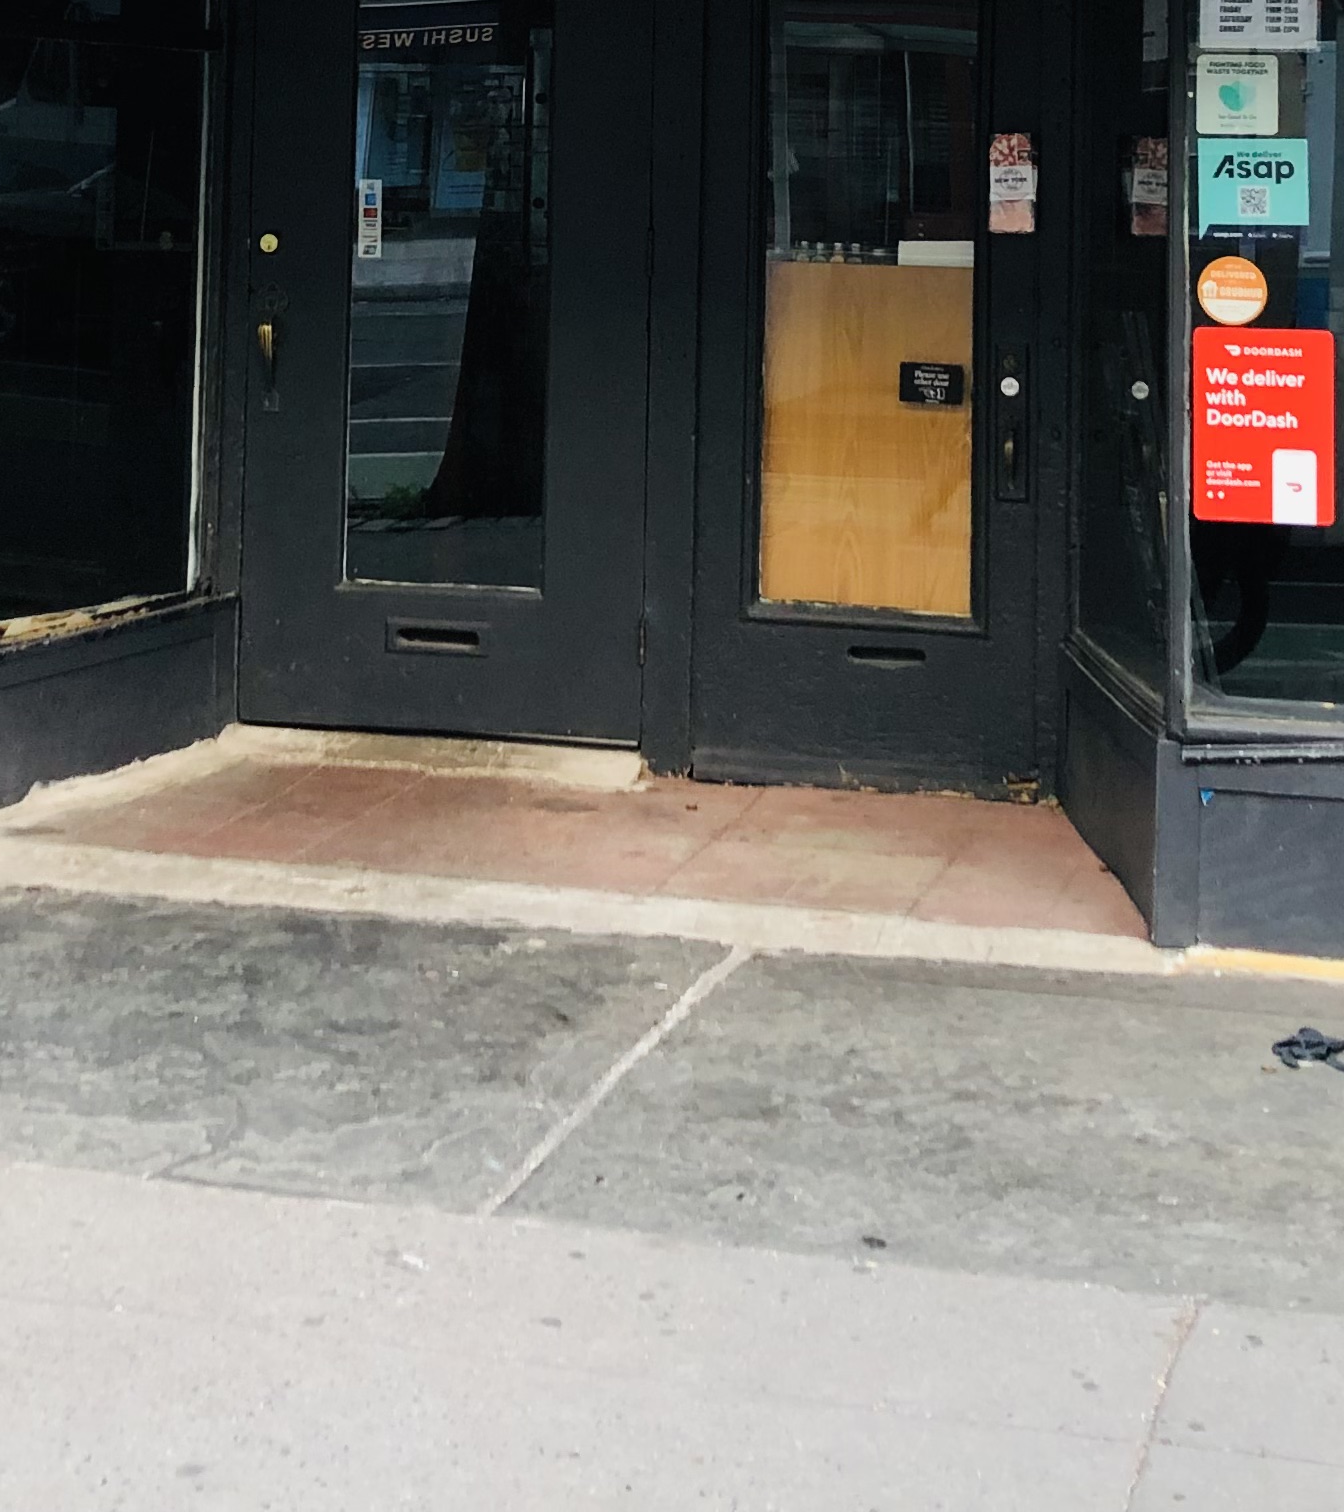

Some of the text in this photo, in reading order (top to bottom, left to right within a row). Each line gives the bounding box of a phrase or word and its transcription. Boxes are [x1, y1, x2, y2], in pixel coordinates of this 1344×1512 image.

[1212, 154, 1295, 185] Asap
[1243, 346, 1303, 358] DOORDASH
[1206, 367, 1306, 388] We deliver
[1205, 388, 1247, 407] with
[1206, 408, 1299, 430] DoorDash
